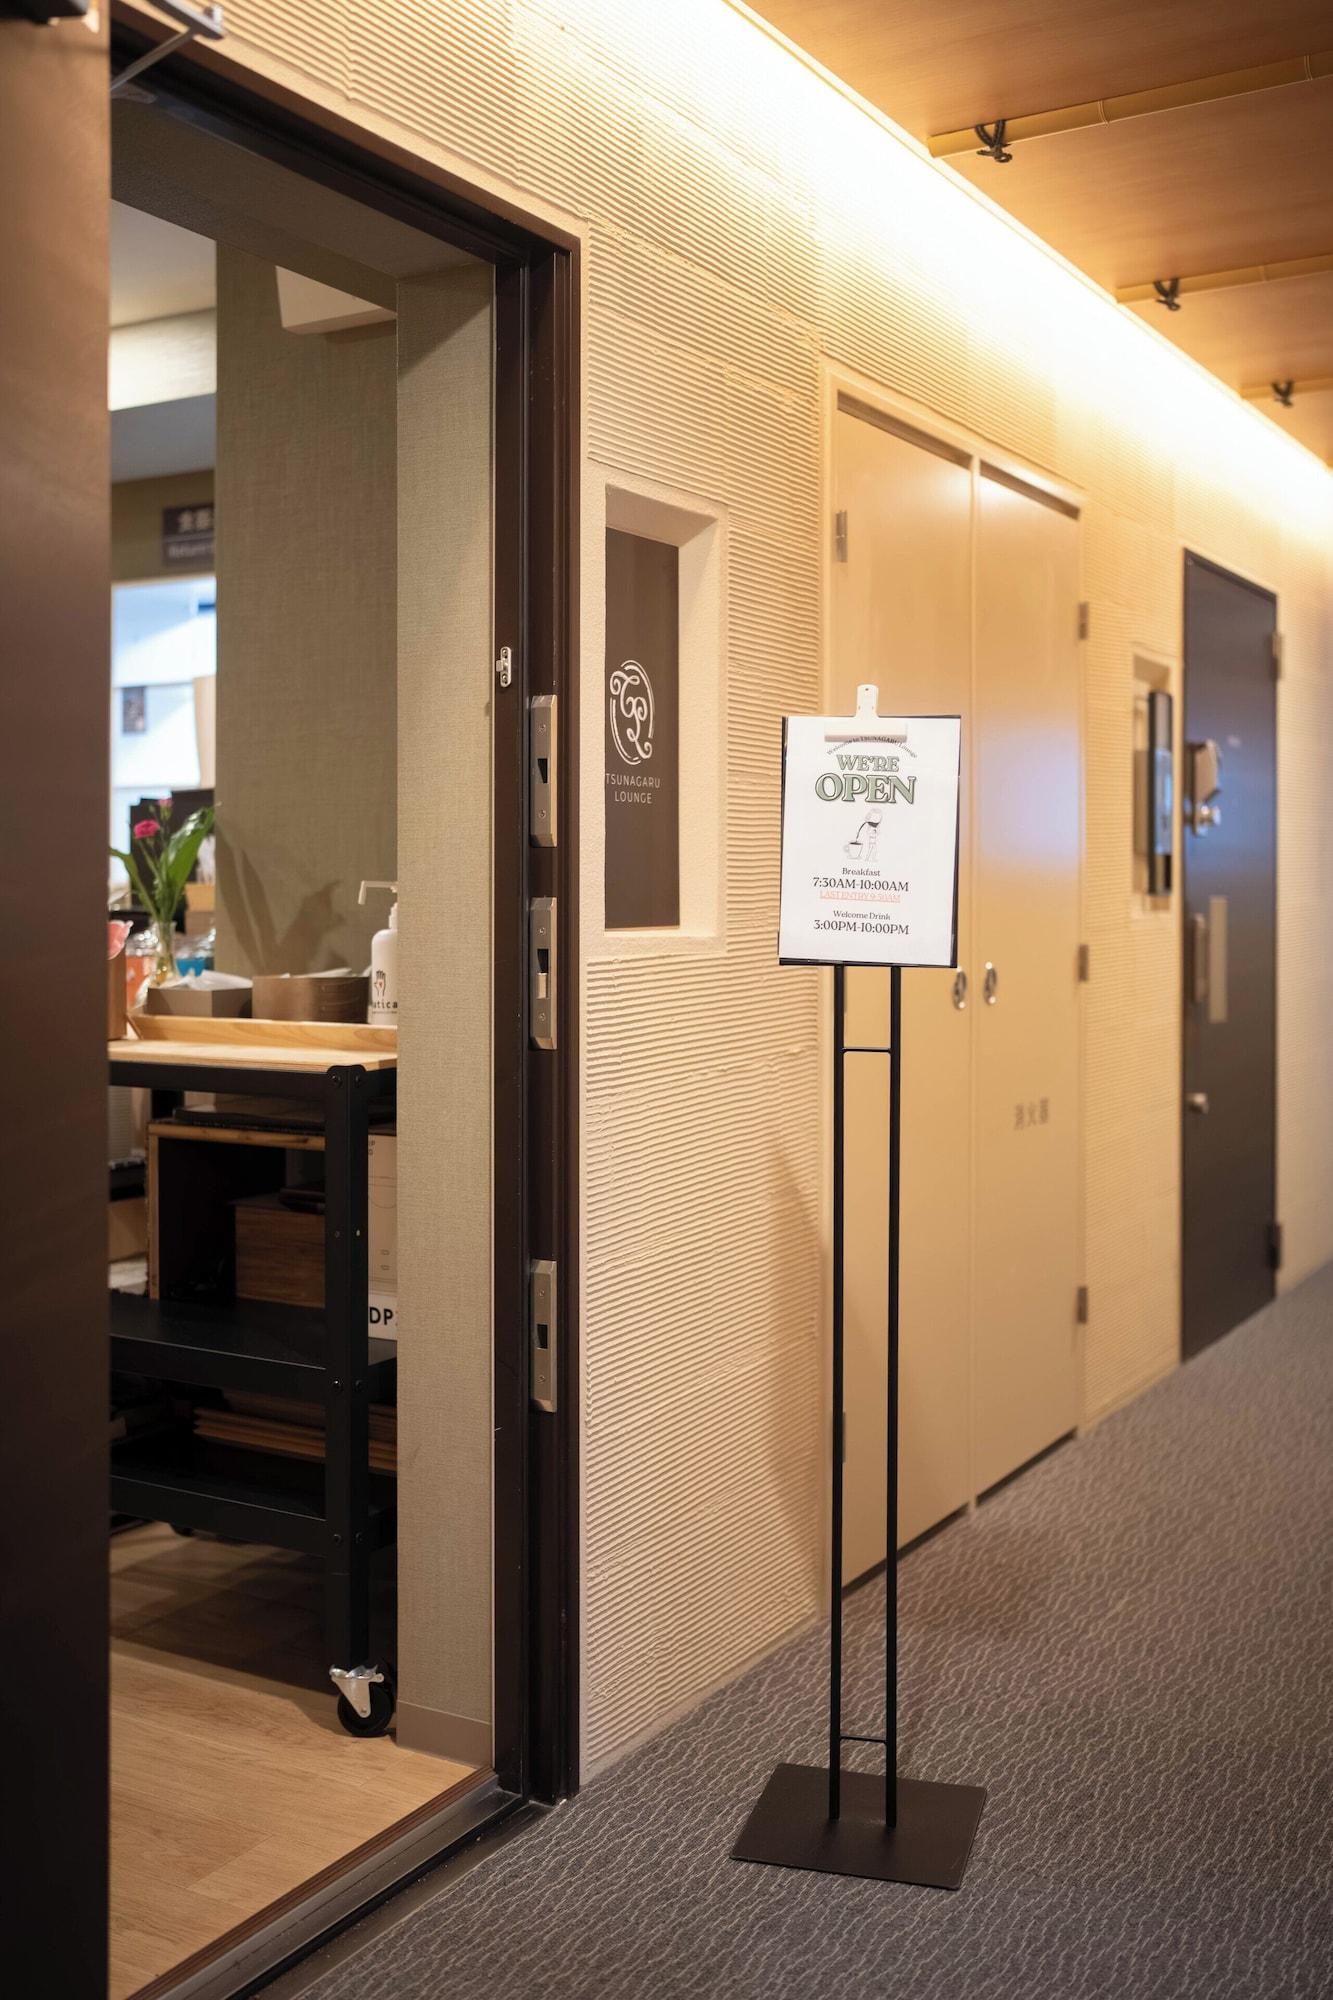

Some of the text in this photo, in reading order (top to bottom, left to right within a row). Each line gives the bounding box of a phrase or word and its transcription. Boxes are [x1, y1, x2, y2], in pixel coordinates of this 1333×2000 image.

[836, 754, 900, 772] WE'RE
[605, 773, 661, 788] TSUNAGARU
[814, 772, 917, 804] OPEN
[614, 791, 653, 804] LOUNGE
[842, 867, 881, 877] Breakfast
[813, 876, 909, 892] 7:30AM-10:00AM
[820, 889, 841, 899] LAST
[841, 891, 869, 901] ENTRY
[833, 910, 891, 921] Welcome Drink
[813, 919, 910, 935] 3:00PM-10:00PM
[369, 1306, 398, 1326] DP
